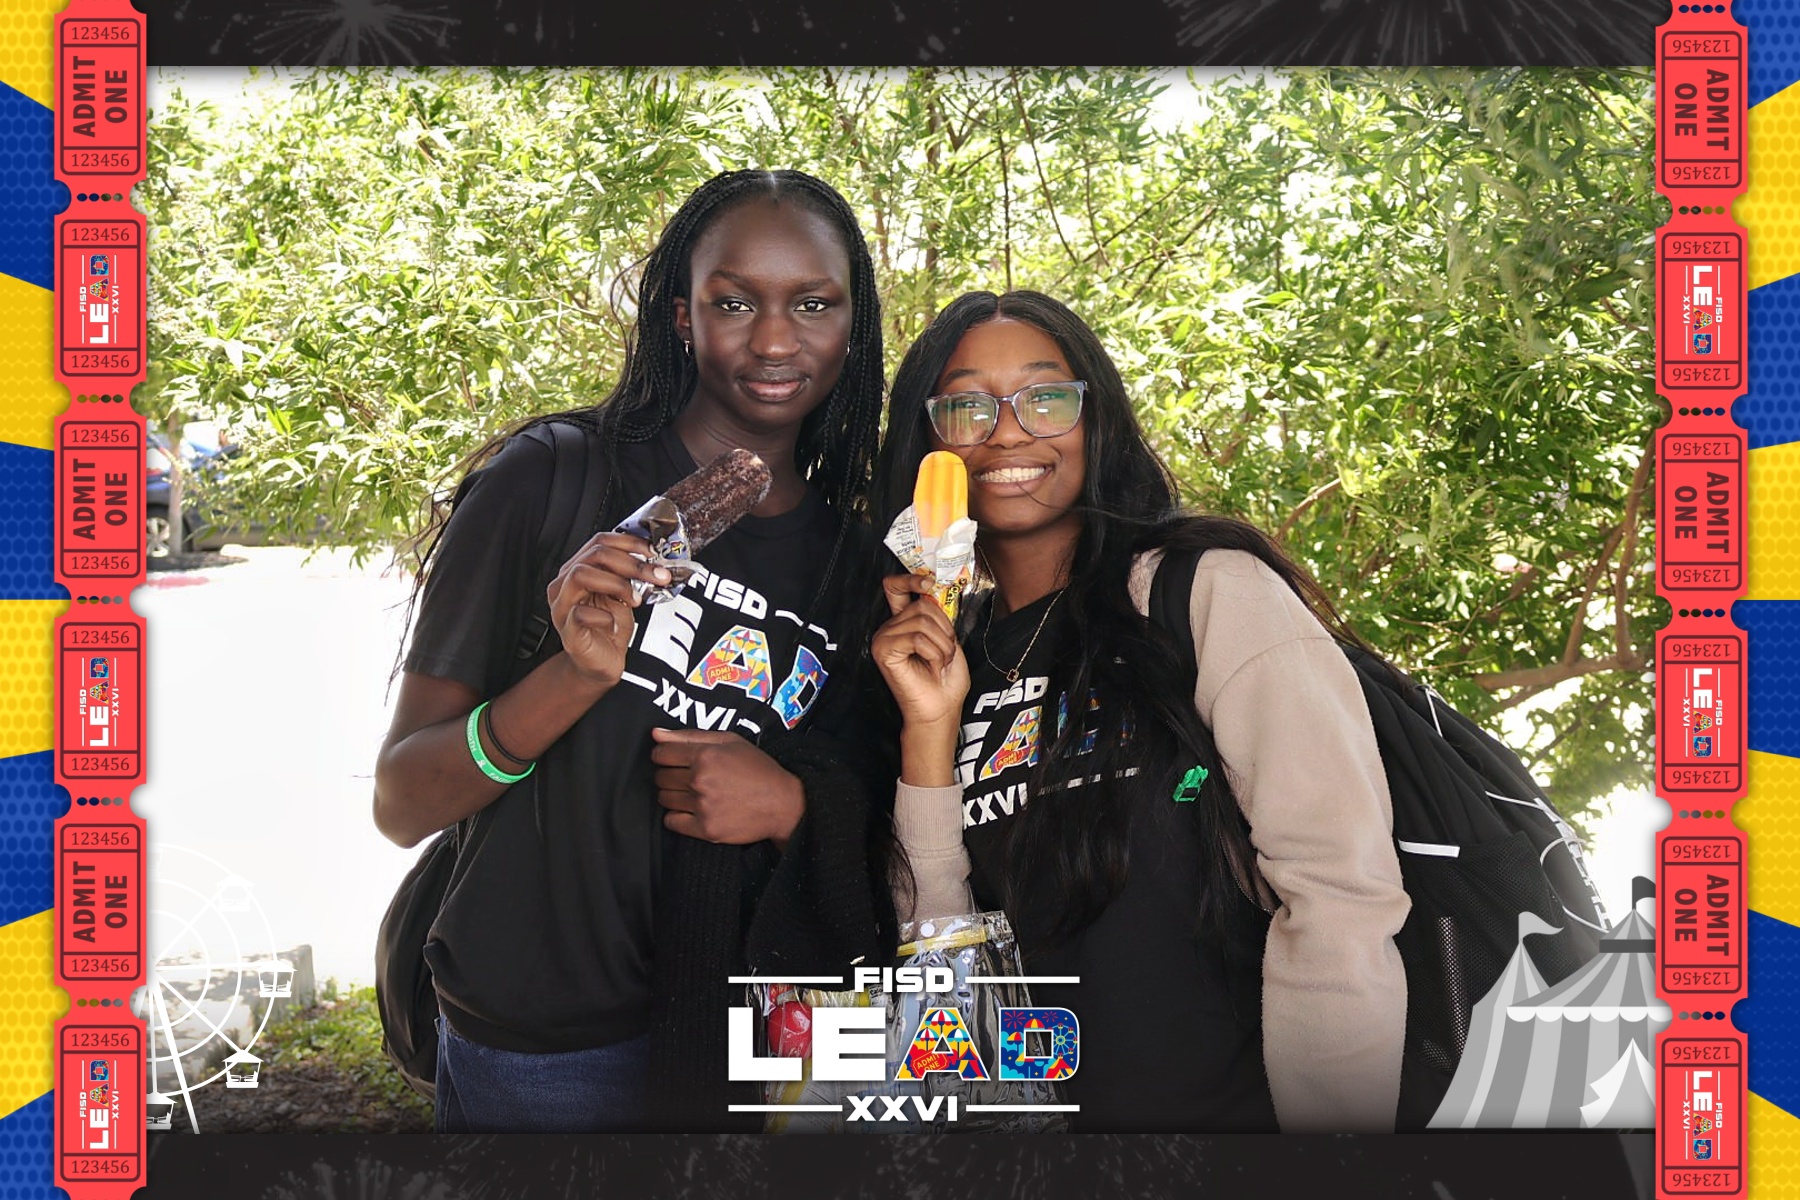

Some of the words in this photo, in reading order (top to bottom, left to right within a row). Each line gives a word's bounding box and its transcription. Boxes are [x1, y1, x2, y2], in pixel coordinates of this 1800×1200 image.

[688, 571, 768, 620] FISD
[653, 678, 737, 731] XXVI
[973, 676, 1049, 715] FISD
[963, 782, 1028, 830] XXVI
